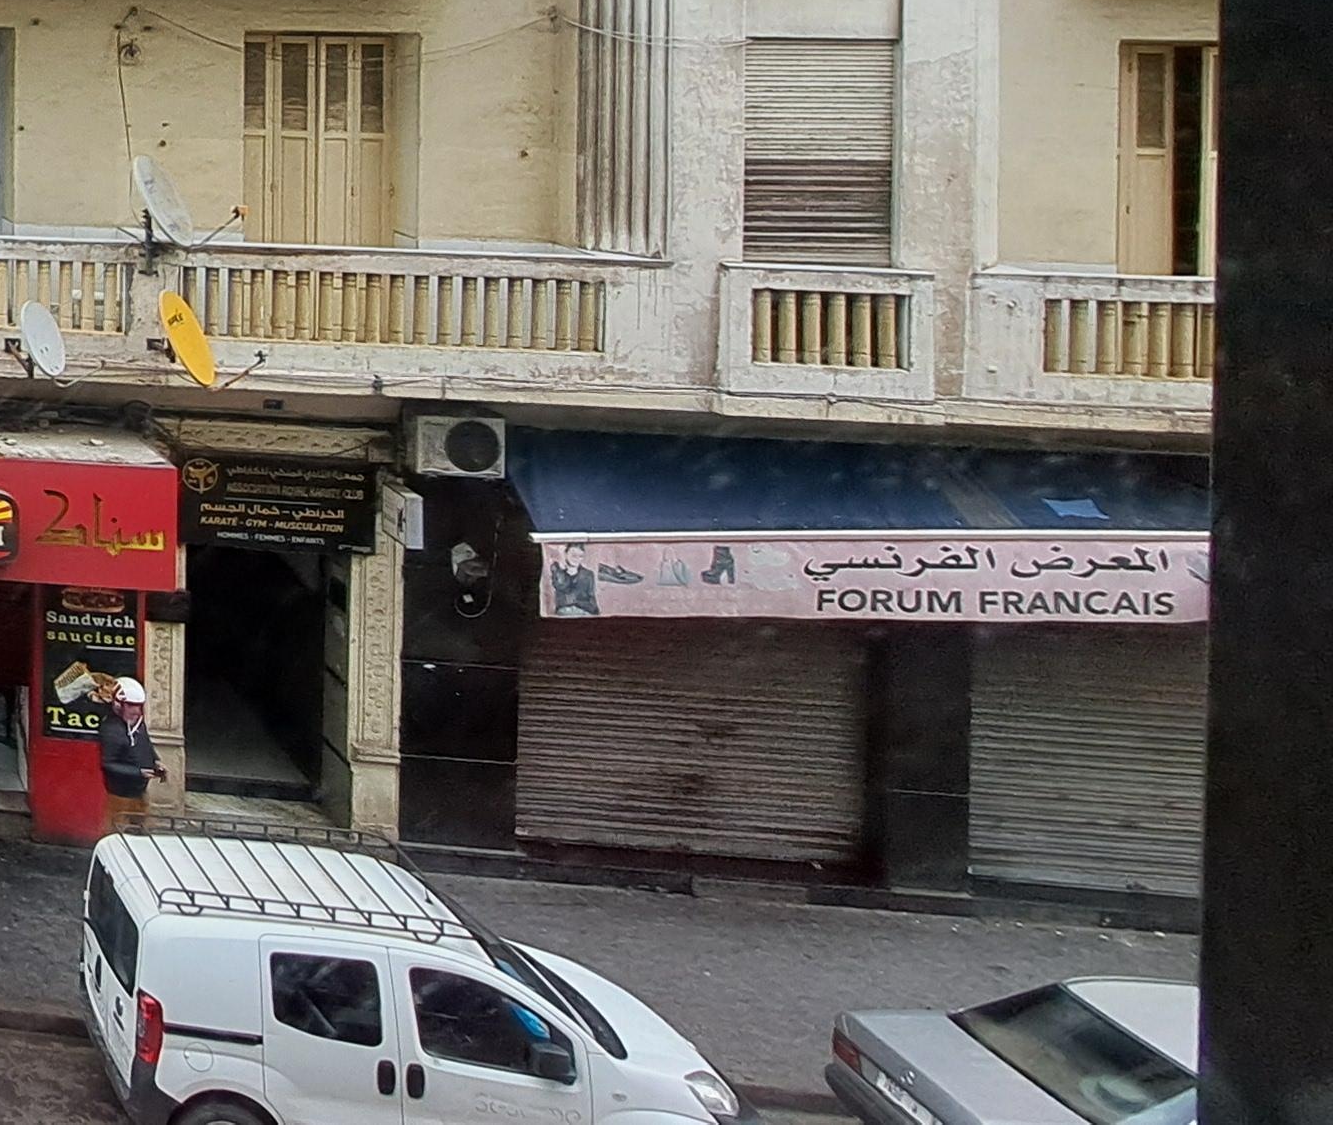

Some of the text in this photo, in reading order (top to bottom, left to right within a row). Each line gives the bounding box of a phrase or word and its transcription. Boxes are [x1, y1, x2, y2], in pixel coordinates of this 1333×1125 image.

[35, 489, 165, 557] سناك
[245, 518, 268, 528] GYM
[274, 520, 344, 533] MUSCULATION
[803, 545, 1169, 582] المعرض الفرنسي
[816, 589, 1174, 616] FORUM FRANCAIS
[46, 610, 135, 628] Sandwich
[46, 629, 135, 646] saucisse
[46, 706, 100, 728] Tac
